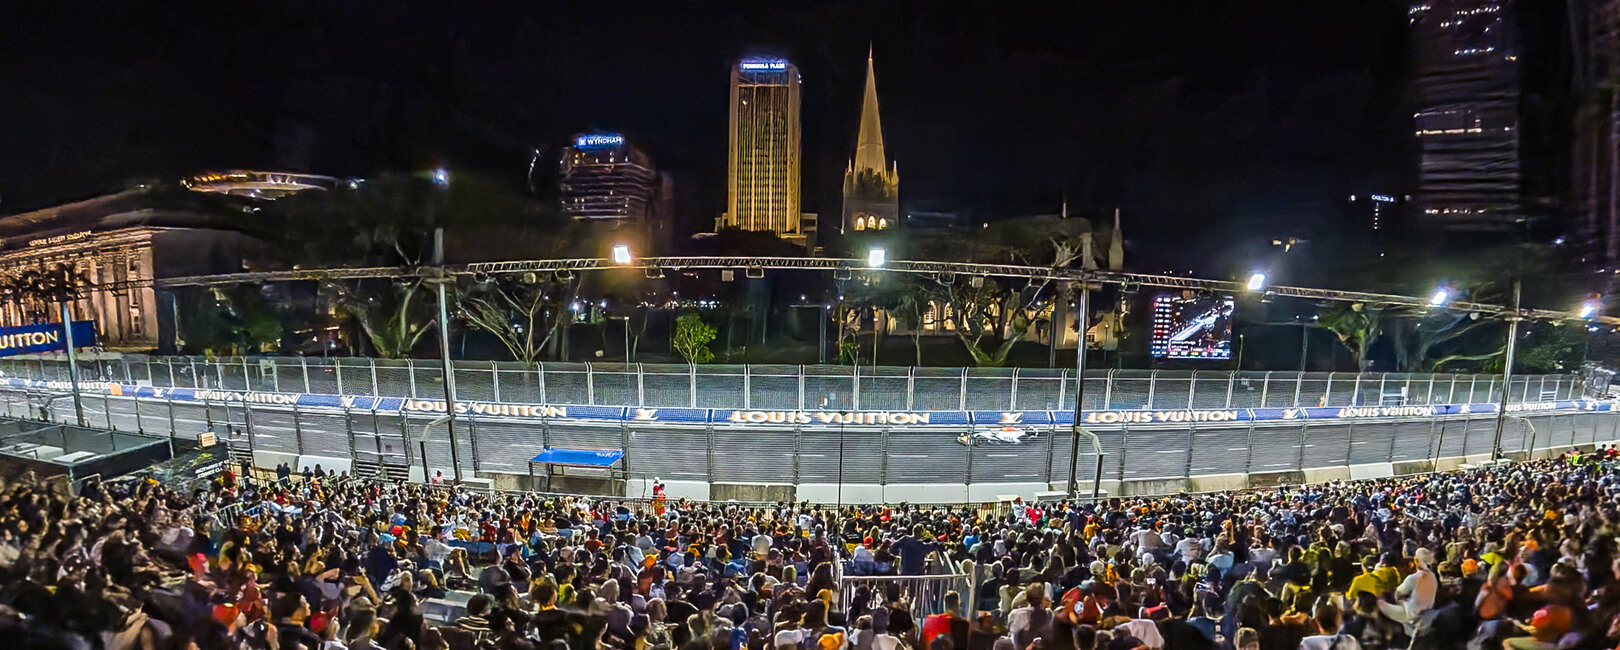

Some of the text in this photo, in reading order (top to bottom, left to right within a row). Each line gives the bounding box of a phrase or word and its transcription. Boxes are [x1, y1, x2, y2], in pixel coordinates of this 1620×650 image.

[587, 137, 622, 145] WYNDHAM
[406, 400, 567, 417] LOUS VUITTON
[1338, 407, 1380, 418] LOUIS
[729, 410, 930, 424] LOUIS VUITTON
[1087, 410, 1238, 423] LOUIS VUITTON
